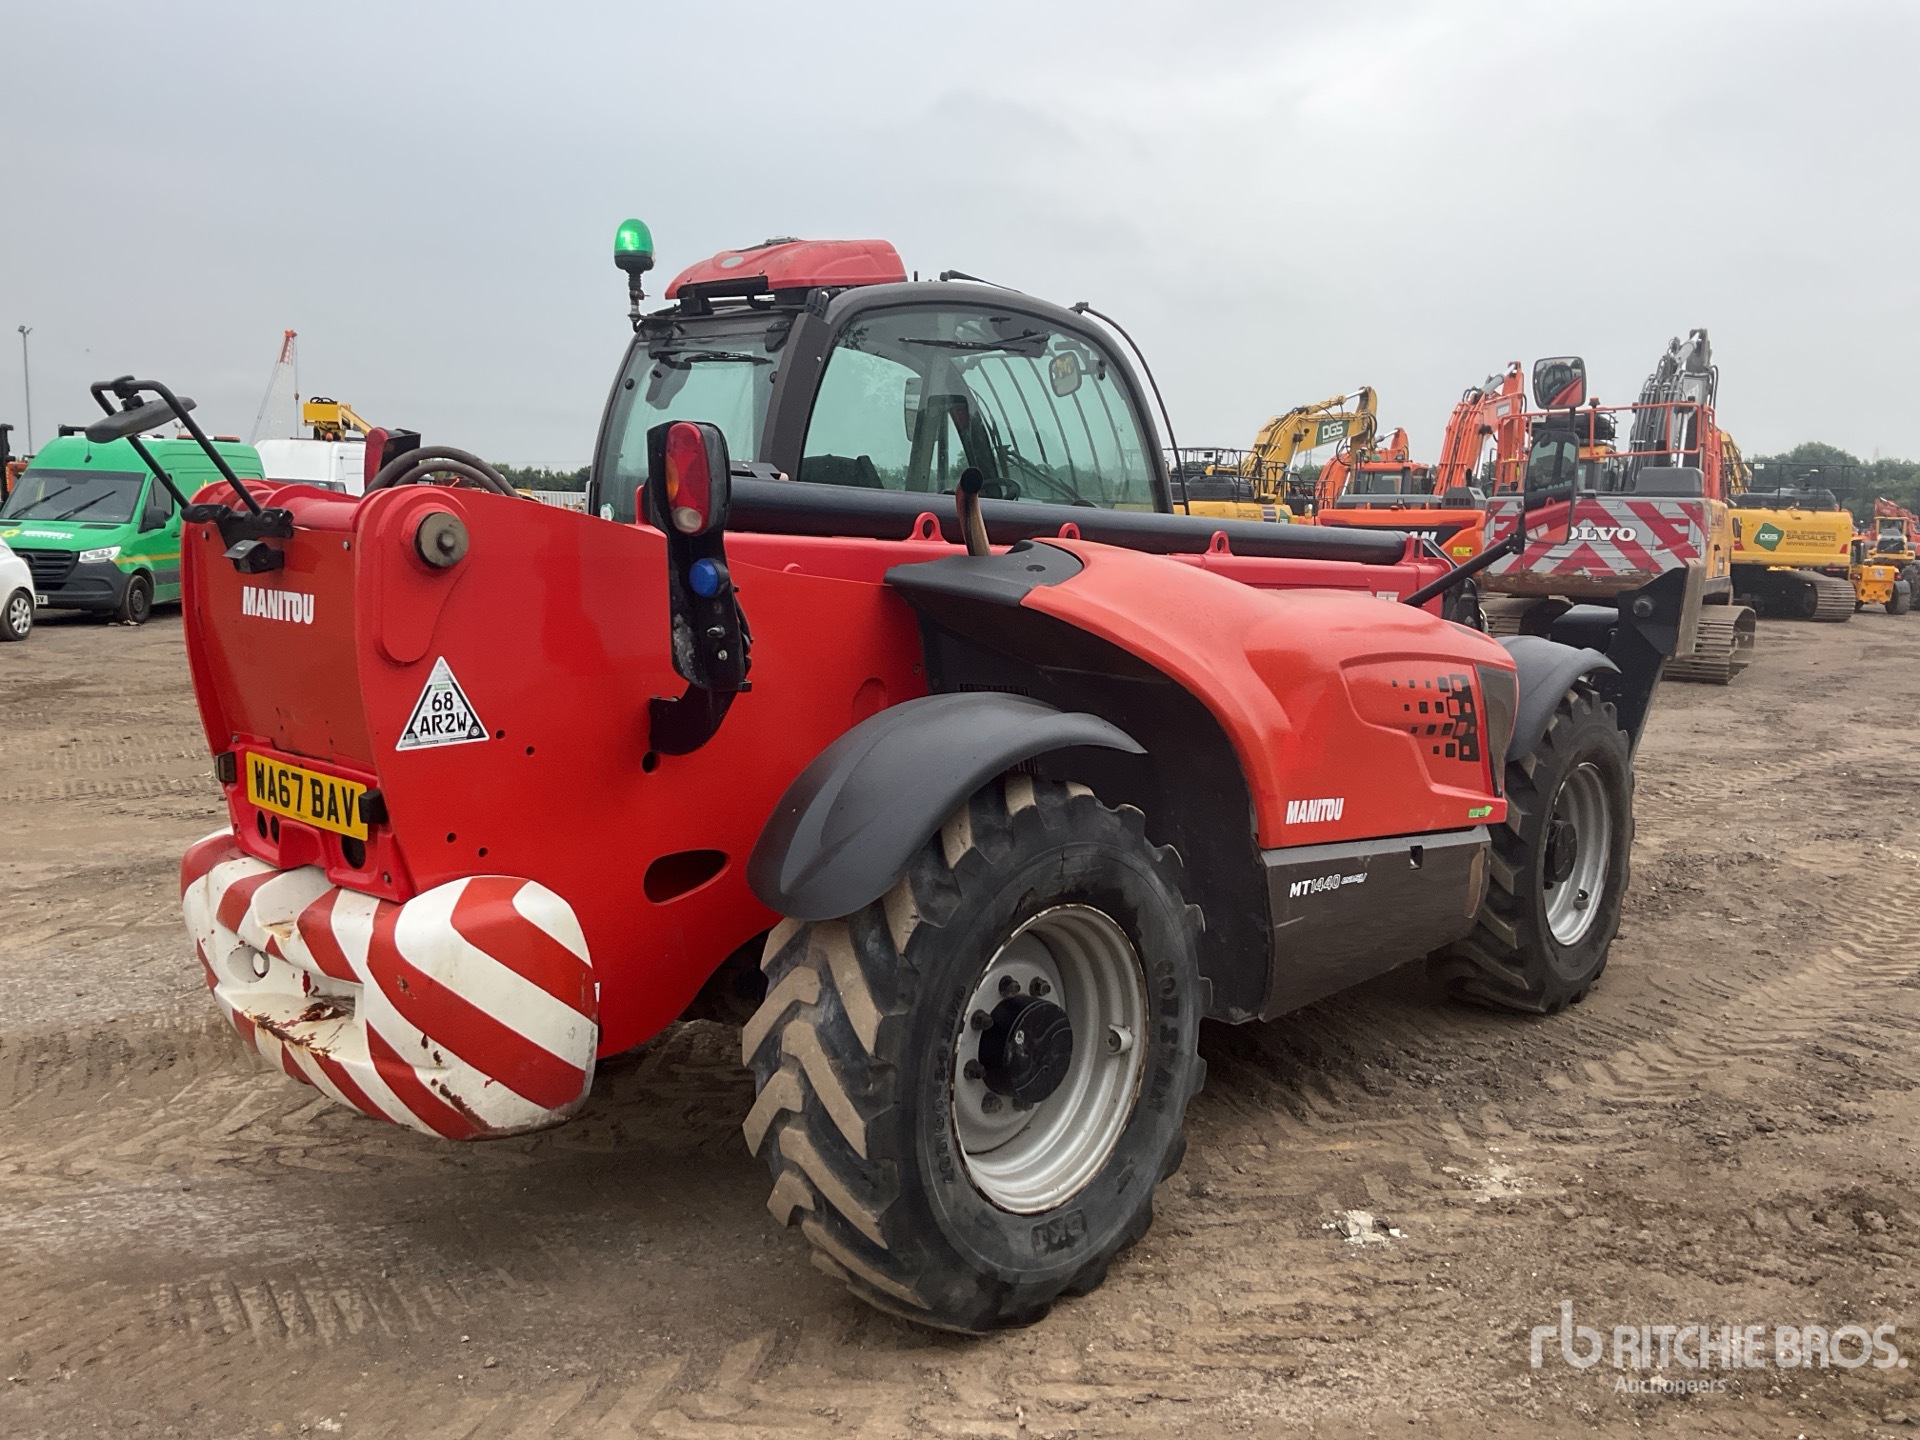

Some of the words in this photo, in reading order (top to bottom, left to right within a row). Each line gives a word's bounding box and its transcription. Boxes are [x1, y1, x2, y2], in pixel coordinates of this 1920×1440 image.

[1322, 421, 1343, 439] DGS
[243, 586, 314, 624] MANITOU
[432, 691, 453, 712] 68
[420, 712, 467, 736] AR2W
[255, 761, 303, 812] WA67
[310, 778, 354, 828] BAV
[1285, 798, 1345, 825] MANITOU
[1290, 873, 1340, 898] MT1440
